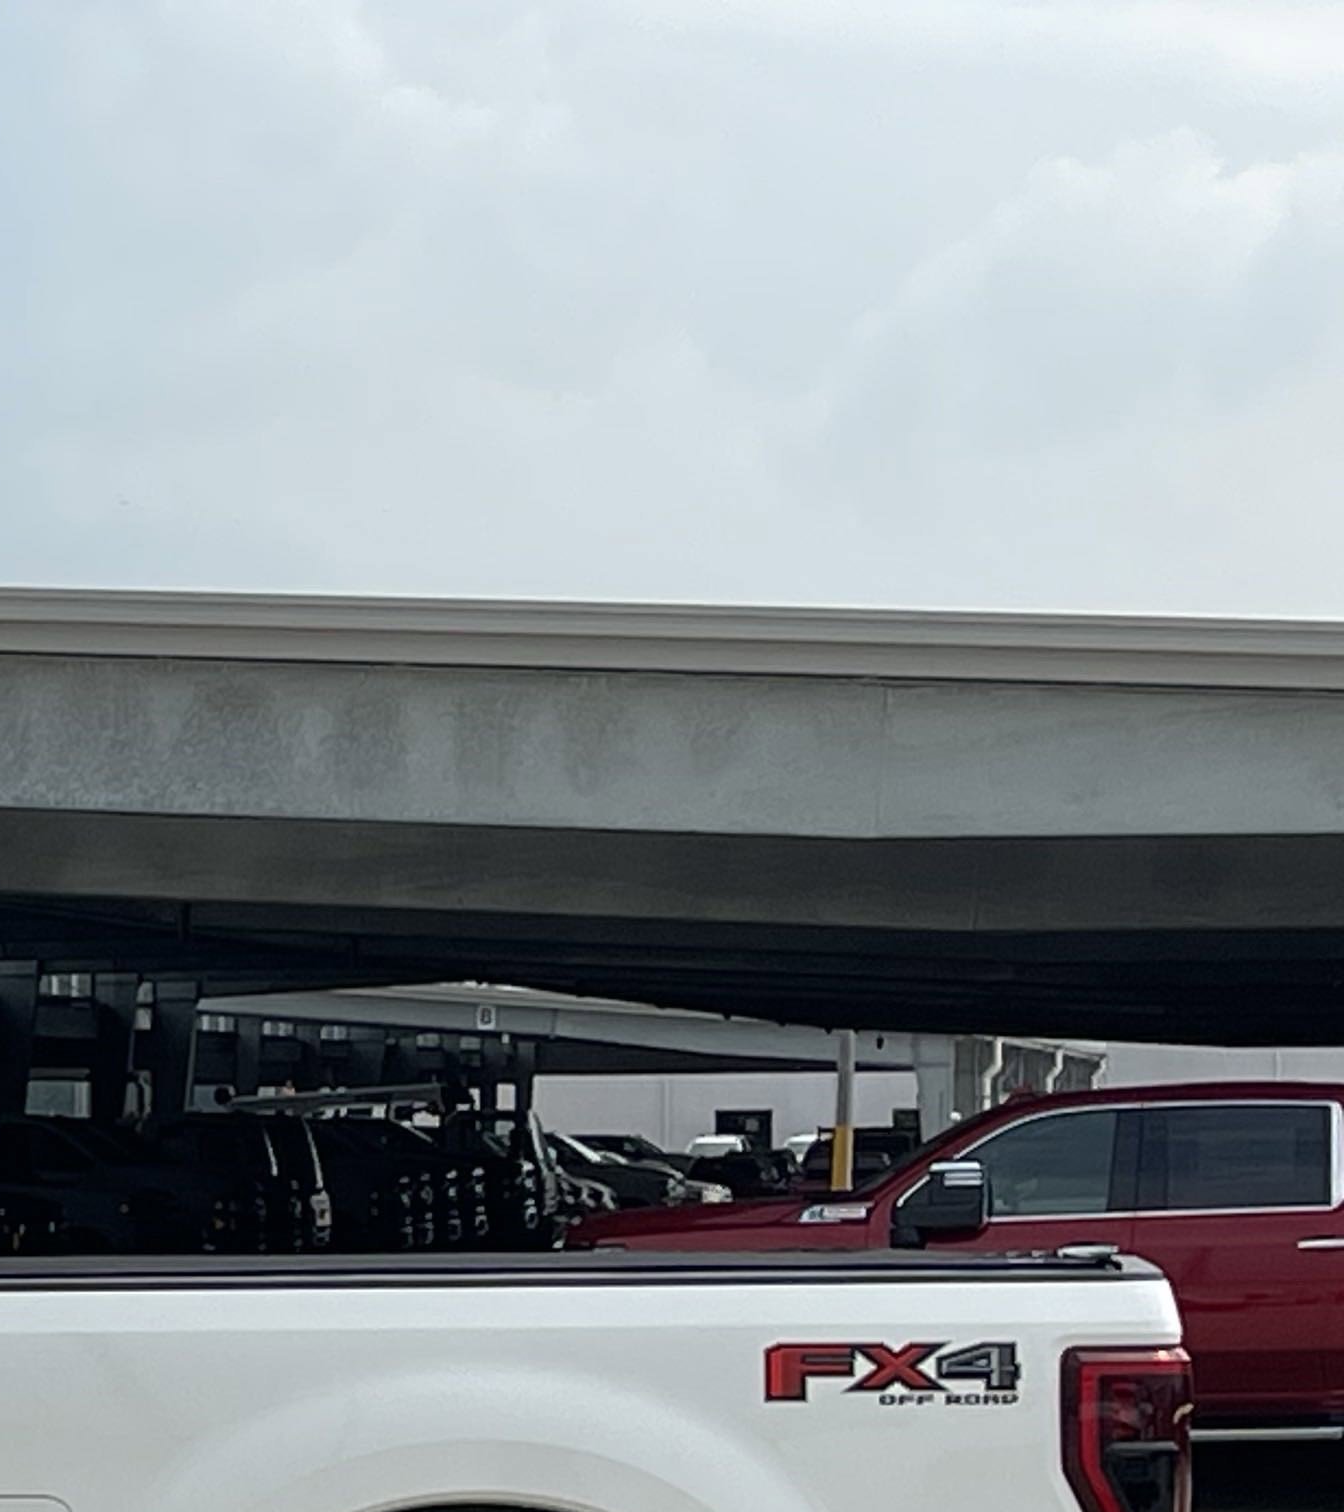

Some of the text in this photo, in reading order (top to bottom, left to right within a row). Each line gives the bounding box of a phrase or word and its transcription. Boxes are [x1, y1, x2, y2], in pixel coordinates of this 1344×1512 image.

[764, 1341, 1022, 1402] FX4
[879, 1394, 1019, 1406] OFF ROAD
